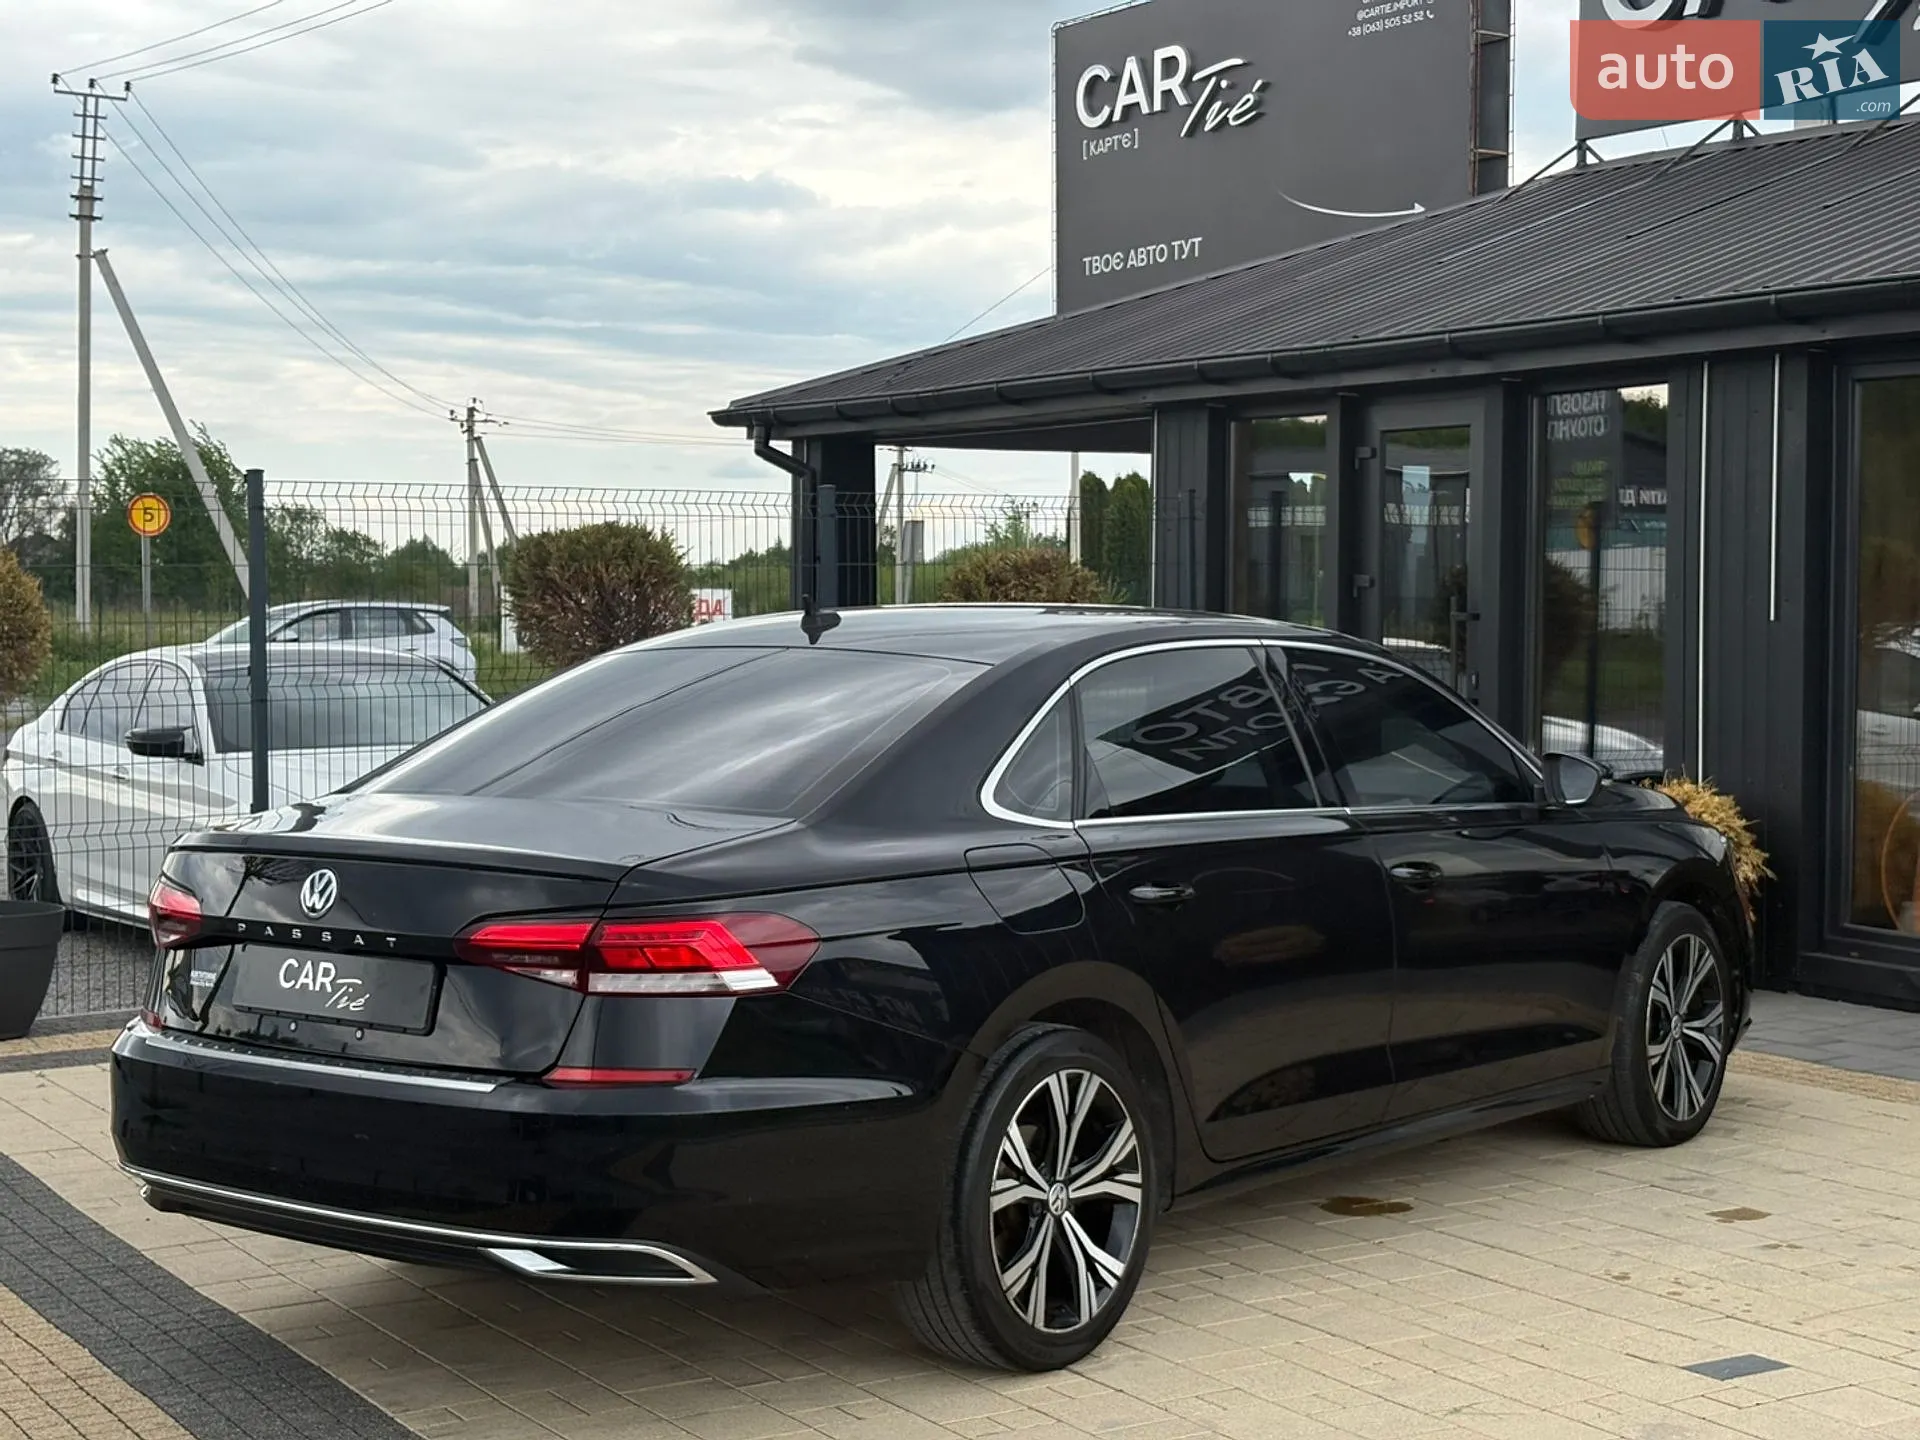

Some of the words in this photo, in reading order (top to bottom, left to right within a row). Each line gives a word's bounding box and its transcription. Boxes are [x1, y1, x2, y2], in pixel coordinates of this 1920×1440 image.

[1082, 253, 1124, 276] ТВОЄ
[1127, 244, 1168, 268] АВТО
[1171, 237, 1203, 261] ТУТ
[236, 922, 397, 948] PASSAT
